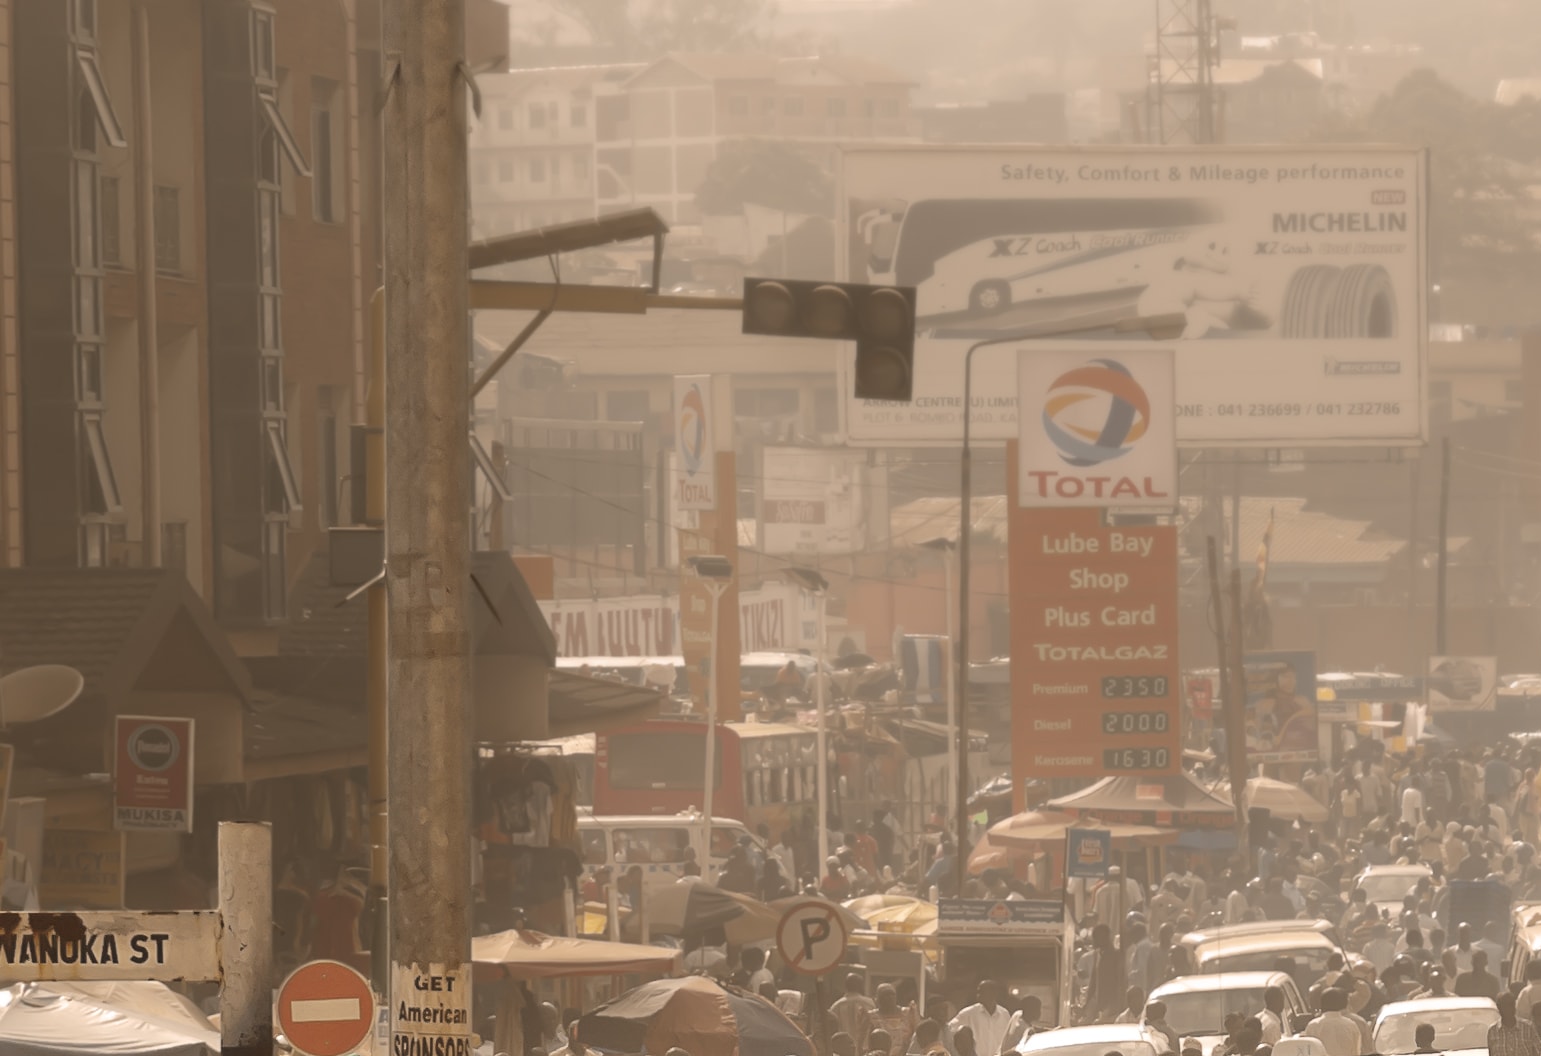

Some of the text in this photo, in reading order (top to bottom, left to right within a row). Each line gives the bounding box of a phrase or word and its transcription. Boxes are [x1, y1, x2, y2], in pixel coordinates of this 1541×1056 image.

[1000, 163, 1405, 184] Safety, Comfort & Mileage performance
[1372, 191, 1406, 203] NEW
[1271, 211, 1407, 233] MICHELIN
[1035, 233, 1082, 254] Coach
[915, 396, 961, 408] CENTRE
[1216, 403, 1243, 416] 041
[1248, 402, 1301, 416] 236699
[1315, 402, 1342, 416] 041
[1346, 401, 1401, 416] 232786
[1042, 532, 1154, 557] Lube Bay
[1069, 567, 1130, 593] Shop
[1044, 604, 1156, 628] Plus Card
[1032, 677, 1166, 697] Premium 2350
[1033, 713, 1167, 733] Diesel 2000
[1034, 748, 1168, 768] Kerosene 1630
[117, 807, 185, 823] MUKISA
[129, 934, 169, 965] ST
[414, 975, 456, 992] GET
[398, 1000, 468, 1025] American
